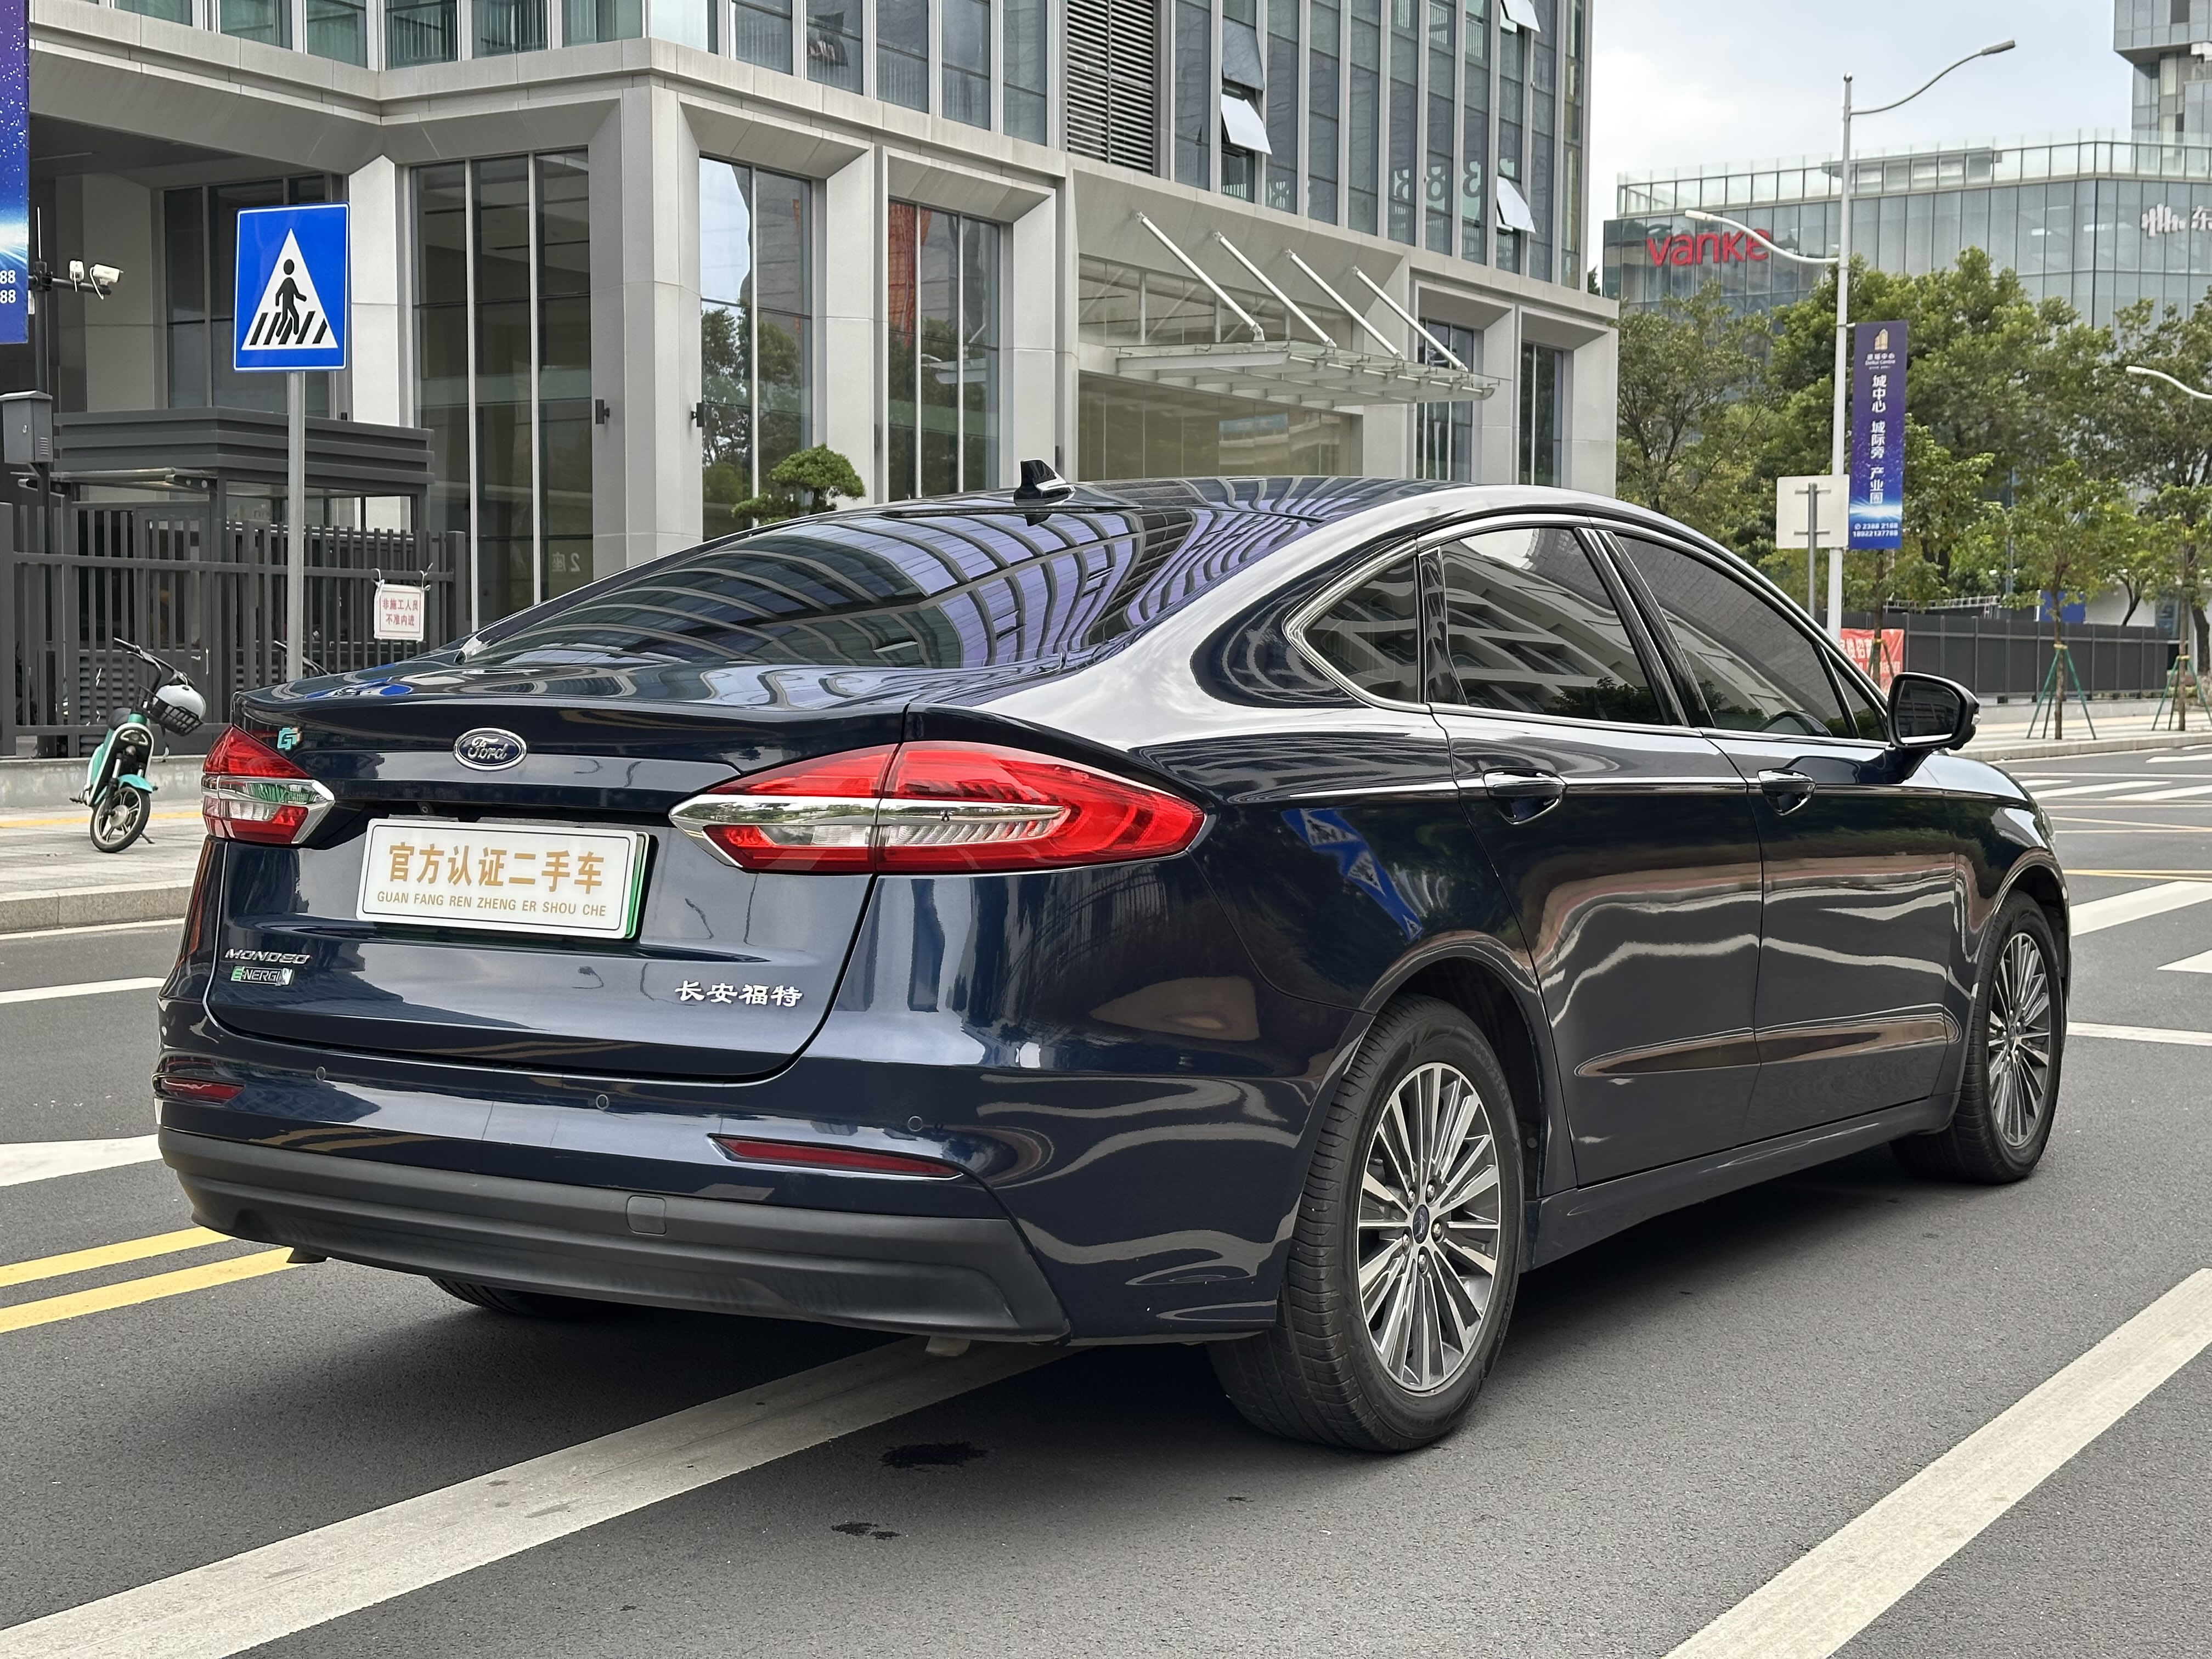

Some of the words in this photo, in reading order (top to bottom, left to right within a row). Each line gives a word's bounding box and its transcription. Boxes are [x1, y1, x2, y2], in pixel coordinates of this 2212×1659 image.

[1645, 228, 1770, 268] vanke
[1872, 375, 1887, 413] 城中心
[1870, 420, 1886, 459] 城际旁
[382, 598, 418, 611] 非施工人员
[386, 613, 415, 626] 不准内进
[467, 736, 509, 760] Ford
[389, 842, 604, 894] 官方认证二手车
[377, 891, 409, 904] GUAN
[414, 893, 444, 906] FANG
[449, 895, 472, 908] REN
[477, 897, 516, 911] ZHENG
[522, 900, 537, 912] ER
[542, 901, 576, 915] SHOU
[583, 904, 606, 917] CHE
[224, 948, 311, 964] MONDEO
[231, 966, 282, 984] ENERGI
[675, 980, 803, 1007] 长安福特
